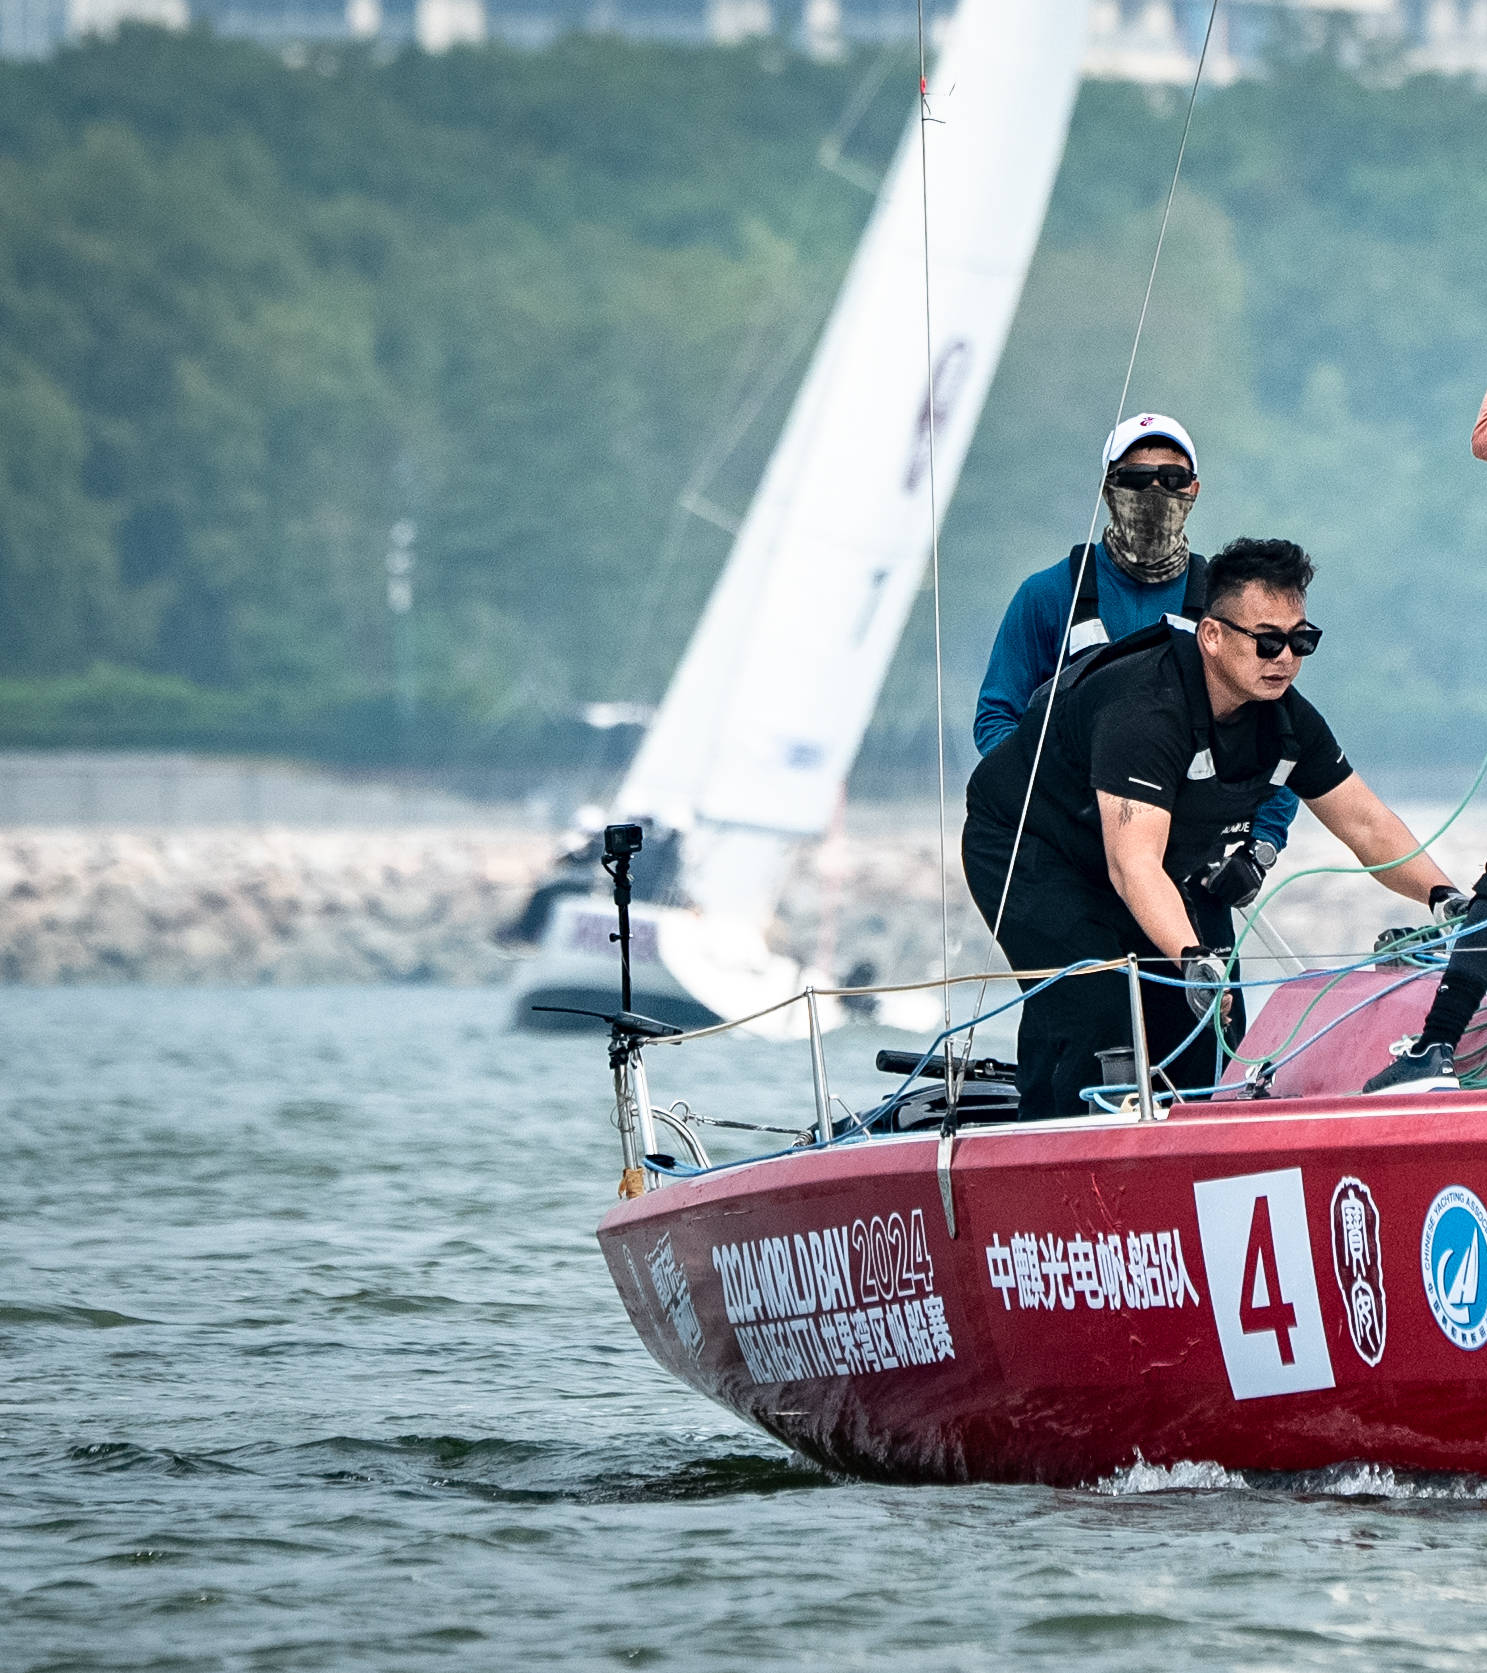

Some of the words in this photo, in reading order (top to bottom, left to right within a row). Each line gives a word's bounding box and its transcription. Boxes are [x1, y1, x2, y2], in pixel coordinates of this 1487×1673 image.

[1434, 1192, 1465, 1215] YACHTING
[751, 1233, 818, 1320] WORLD
[808, 1226, 856, 1311] BAY
[852, 1209, 933, 1303] 2024
[986, 1229, 1200, 1311] 中麒光电帆船队
[1239, 1195, 1298, 1366] 4
[820, 1294, 955, 1376] 世界湾区帆船赛
